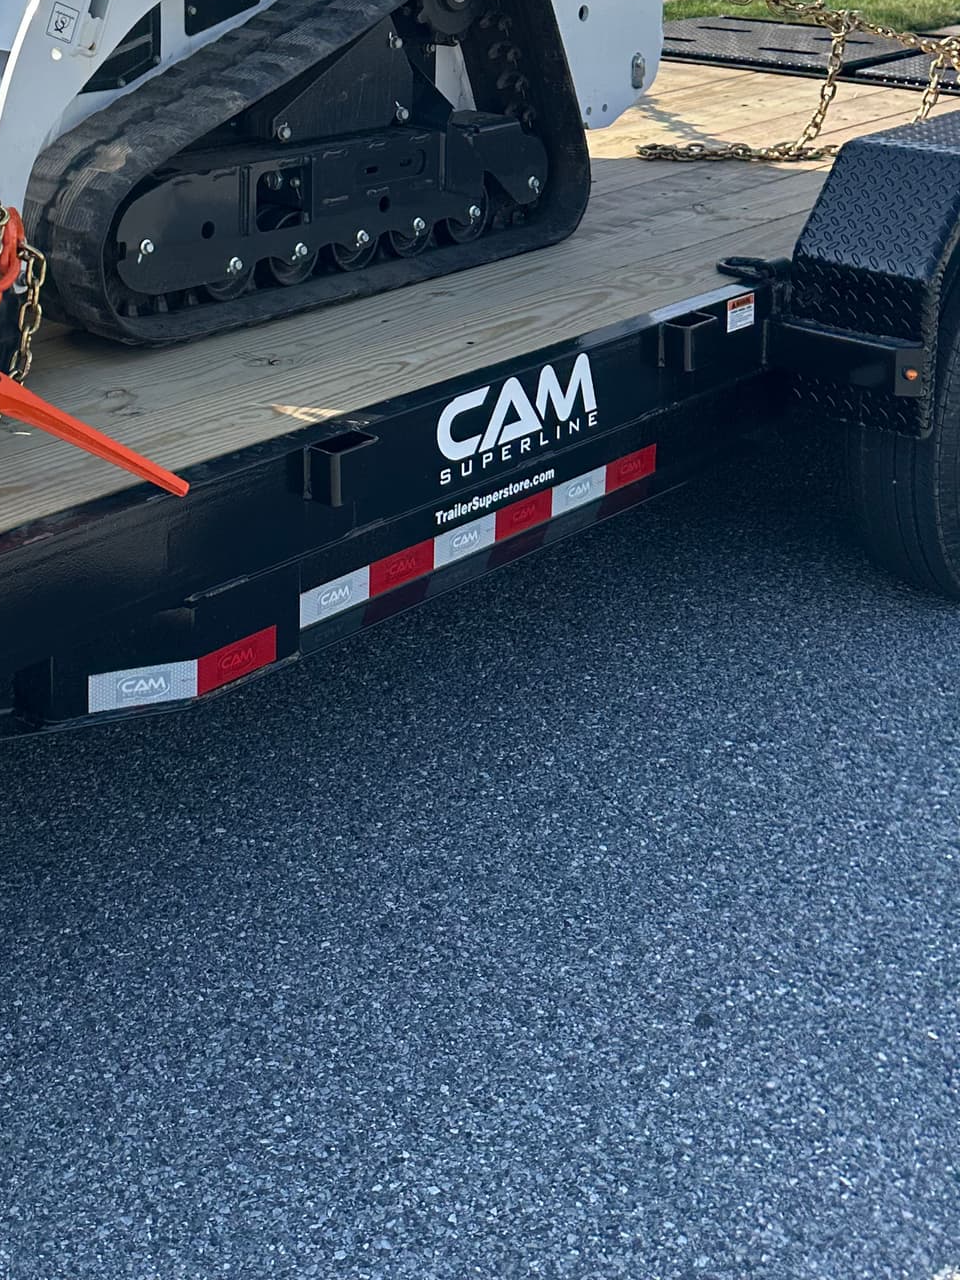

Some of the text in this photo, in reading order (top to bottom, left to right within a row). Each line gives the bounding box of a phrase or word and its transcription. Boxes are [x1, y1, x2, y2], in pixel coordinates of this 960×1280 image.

[436, 352, 598, 461] CAM
[440, 411, 598, 485] SUPERLINE
[434, 468, 555, 525] TrailerSuperstore.com
[453, 530, 478, 548] CAM
[320, 585, 350, 606] CAM
[221, 647, 254, 669] CAM
[121, 676, 166, 693] CAM
